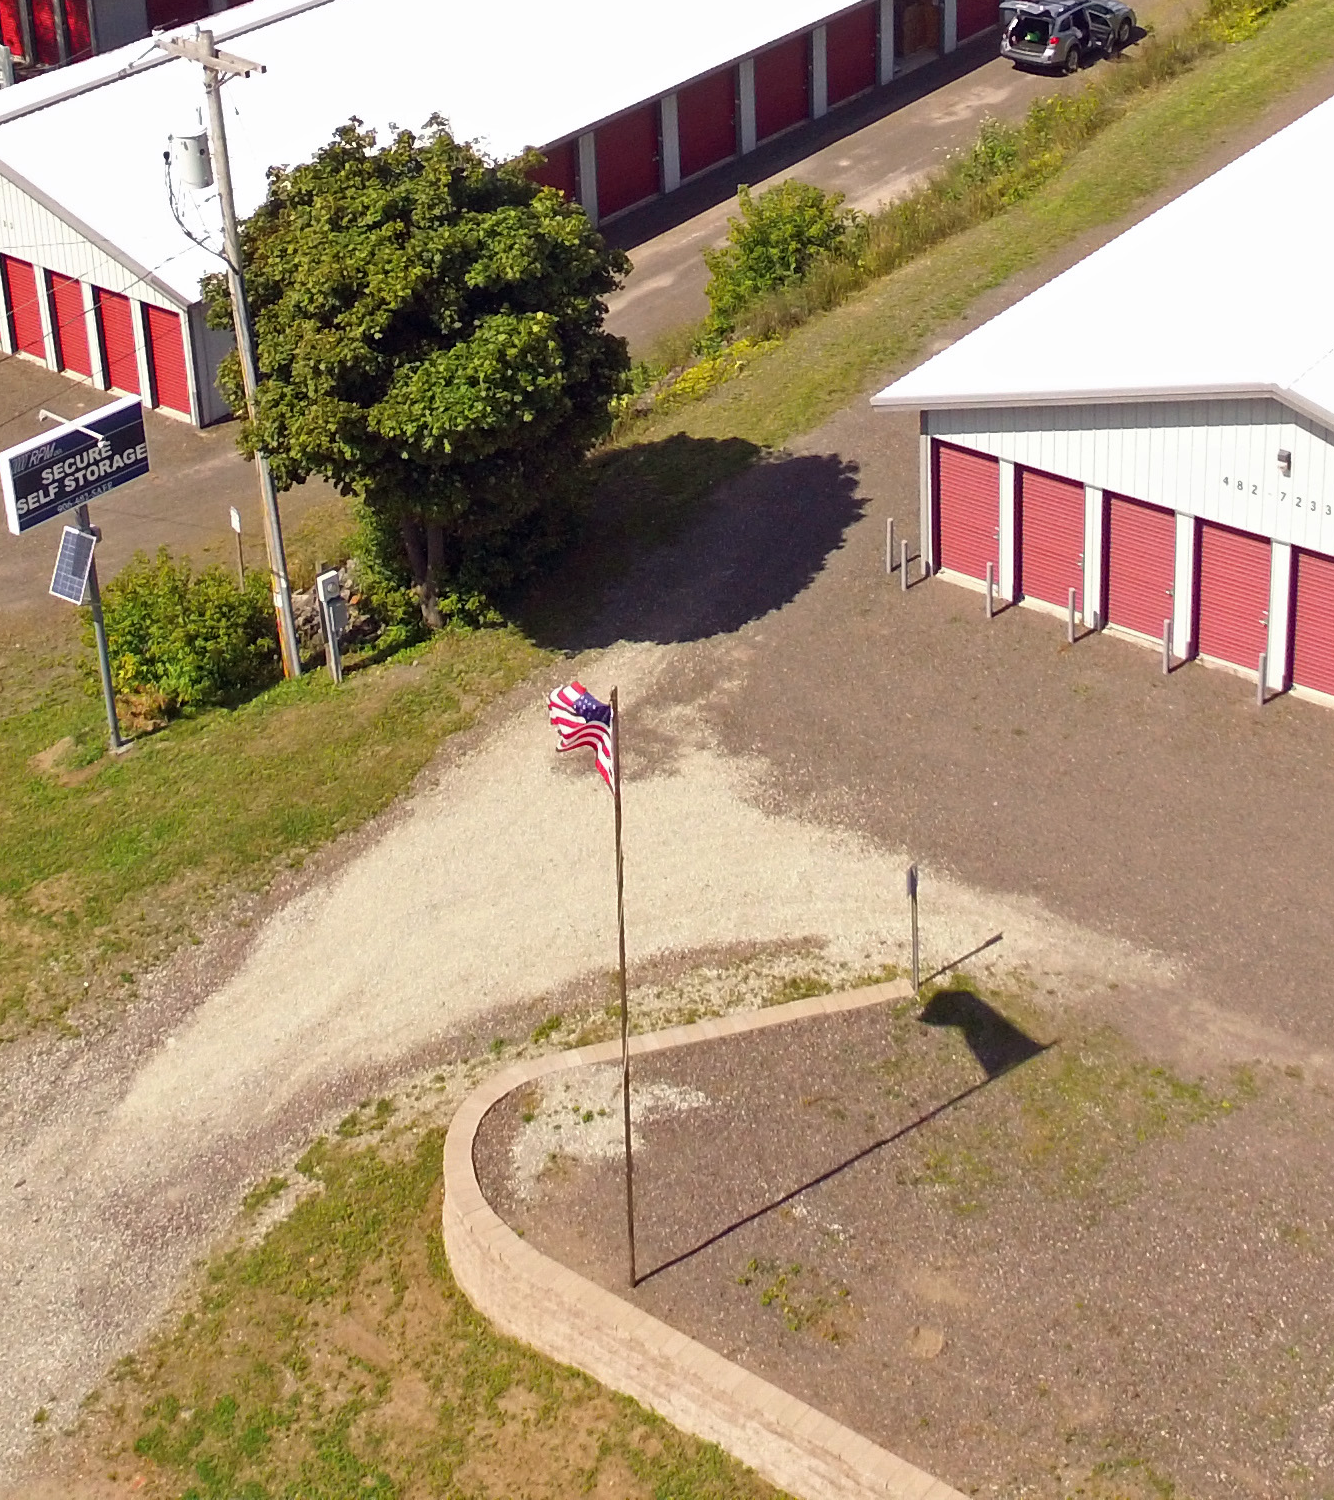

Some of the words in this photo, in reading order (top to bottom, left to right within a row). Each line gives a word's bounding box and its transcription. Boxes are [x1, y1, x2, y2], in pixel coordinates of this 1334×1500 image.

[16, 482, 59, 515] SELF
[64, 442, 148, 492] STORAGE
[41, 440, 113, 485] SECURE
